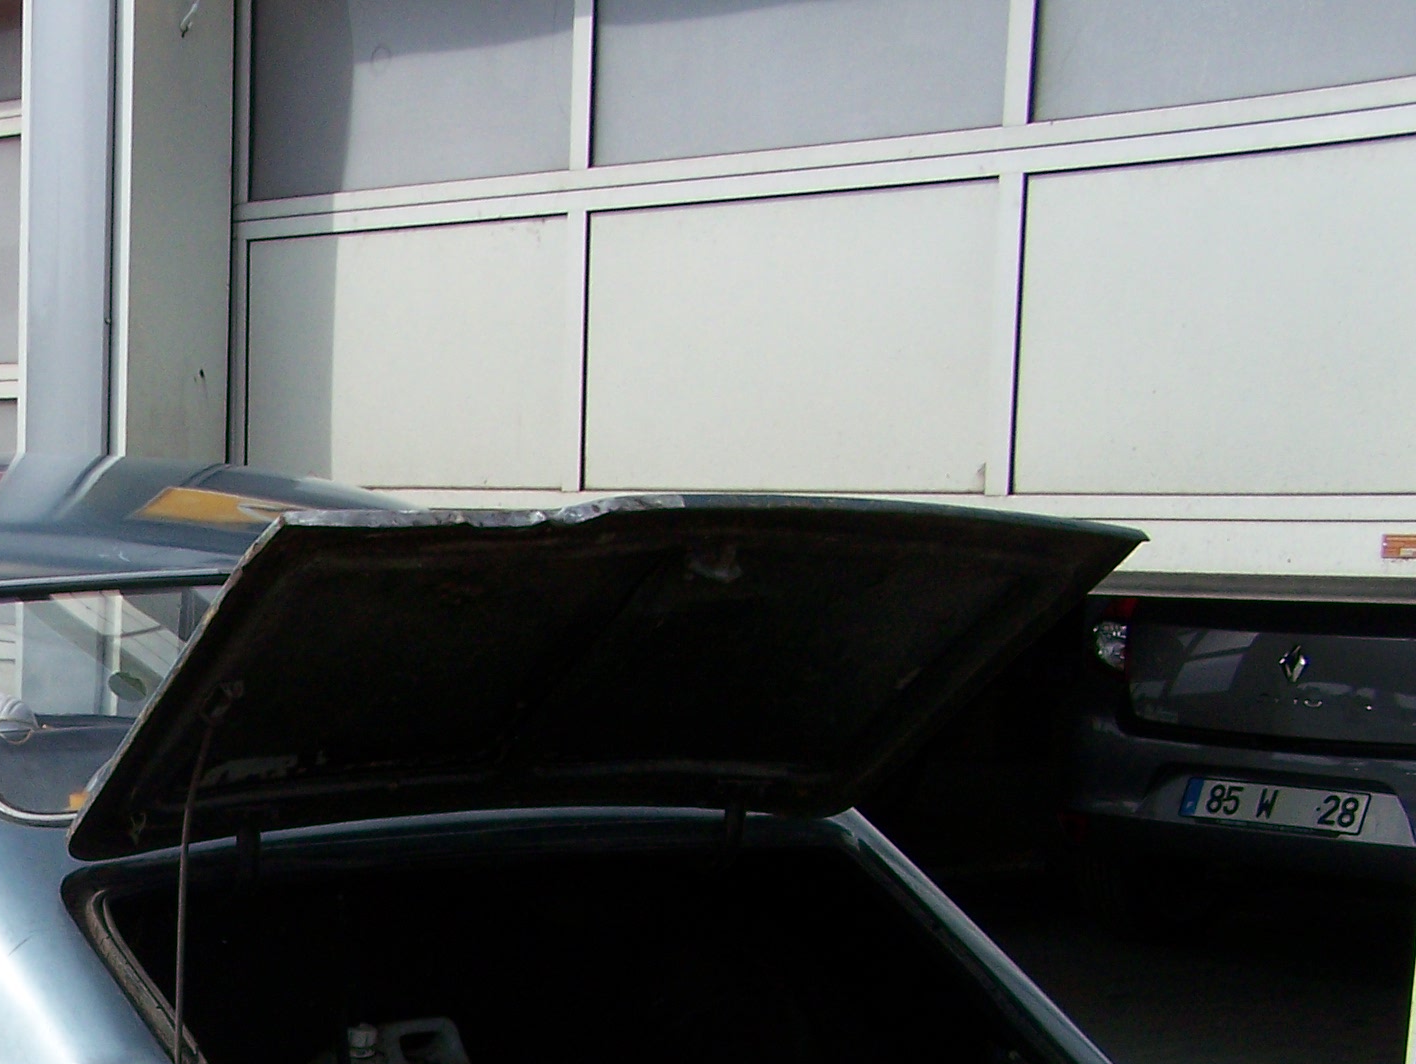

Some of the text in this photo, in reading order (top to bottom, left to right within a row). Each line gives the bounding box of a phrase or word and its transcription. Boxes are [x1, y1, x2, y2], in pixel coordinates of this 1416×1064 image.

[1206, 784, 1359, 828] 85 W 28
